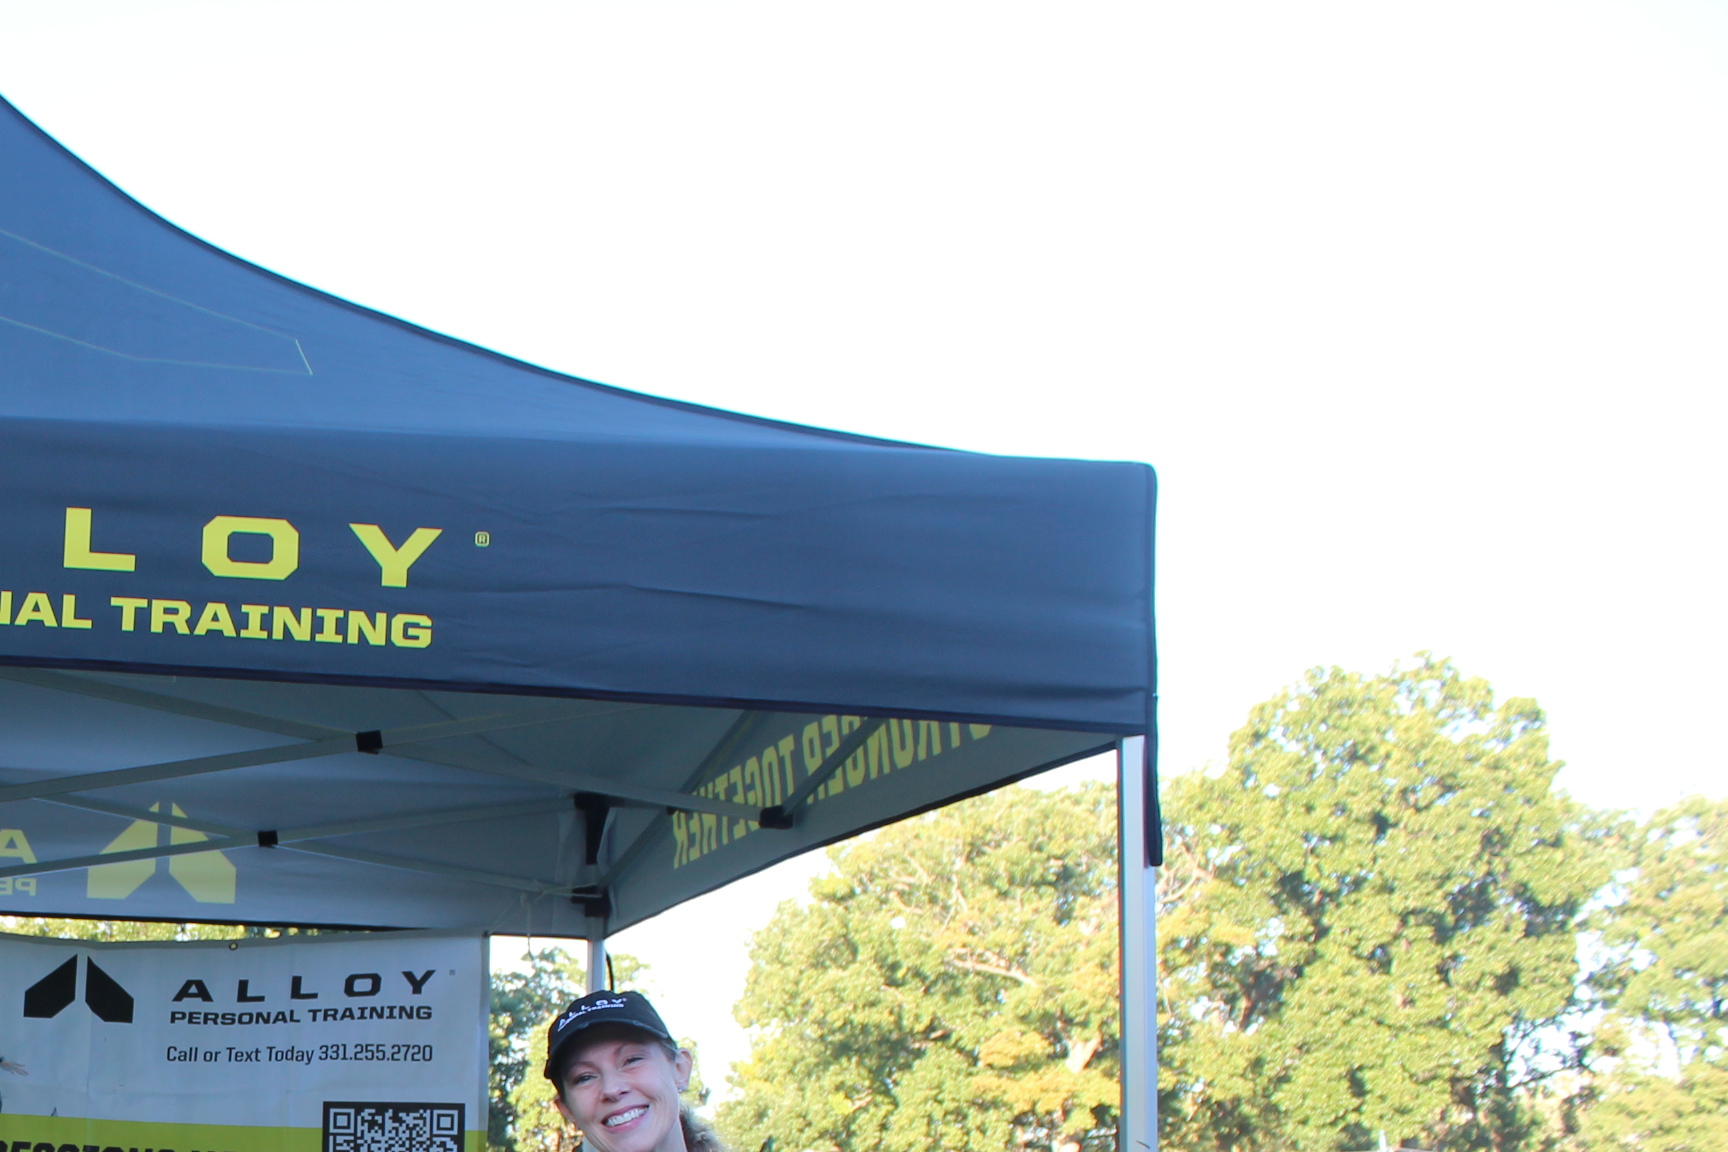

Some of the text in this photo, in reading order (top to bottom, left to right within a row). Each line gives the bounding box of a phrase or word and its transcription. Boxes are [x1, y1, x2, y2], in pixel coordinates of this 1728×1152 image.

[110, 596, 433, 649] TRAINING
[172, 970, 436, 1002] ALLOY
[170, 1006, 432, 1025] PERSONAL TRAINING
[166, 1044, 433, 1065] Call or Text Today 331.255.2720
